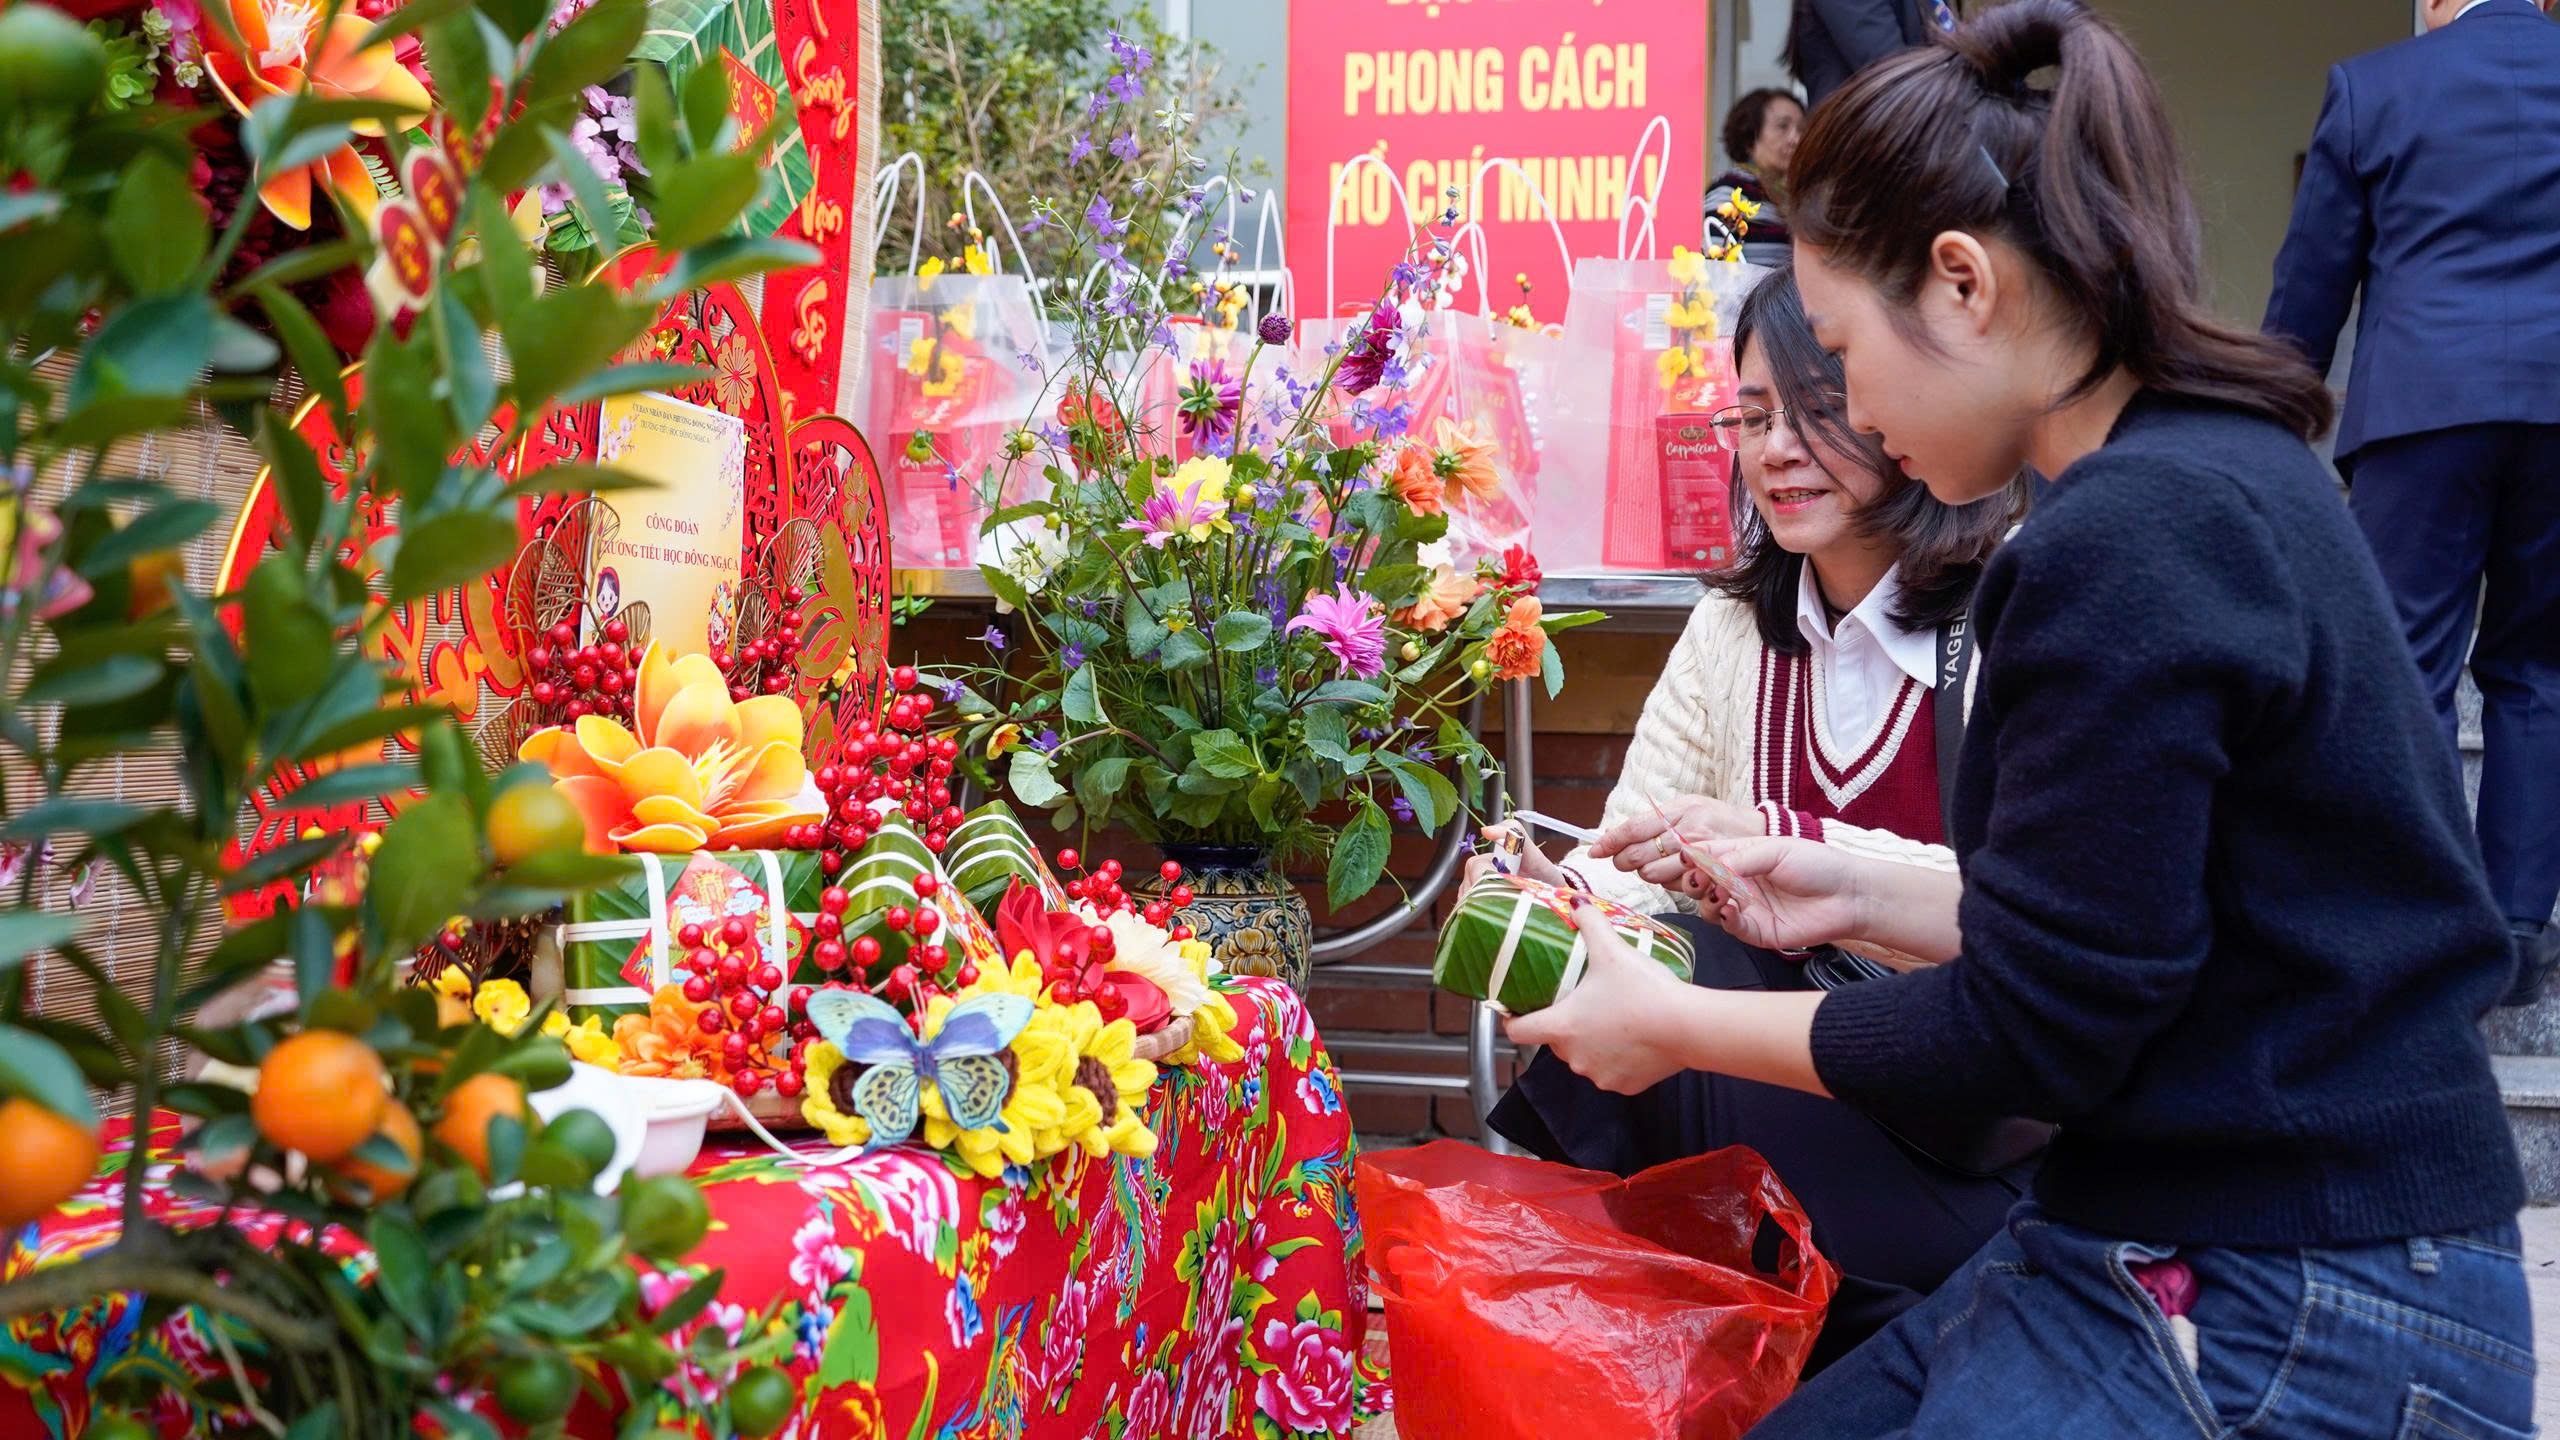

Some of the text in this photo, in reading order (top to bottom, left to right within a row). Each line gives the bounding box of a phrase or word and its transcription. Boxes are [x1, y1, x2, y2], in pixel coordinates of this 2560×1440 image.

[1344, 32, 1648, 117] PHONG CÁCH
[1405, 144, 1485, 224] CHÍ
[1499, 155, 1626, 223] MINH
[646, 512, 699, 536] CÔNG ĐOÀN
[640, 543, 661, 561] TIỂU
[663, 548, 683, 566] HỌC
[684, 548, 709, 568] ĐÔNG
[711, 555, 735, 572] NGẠC
[734, 560, 739, 571] A
